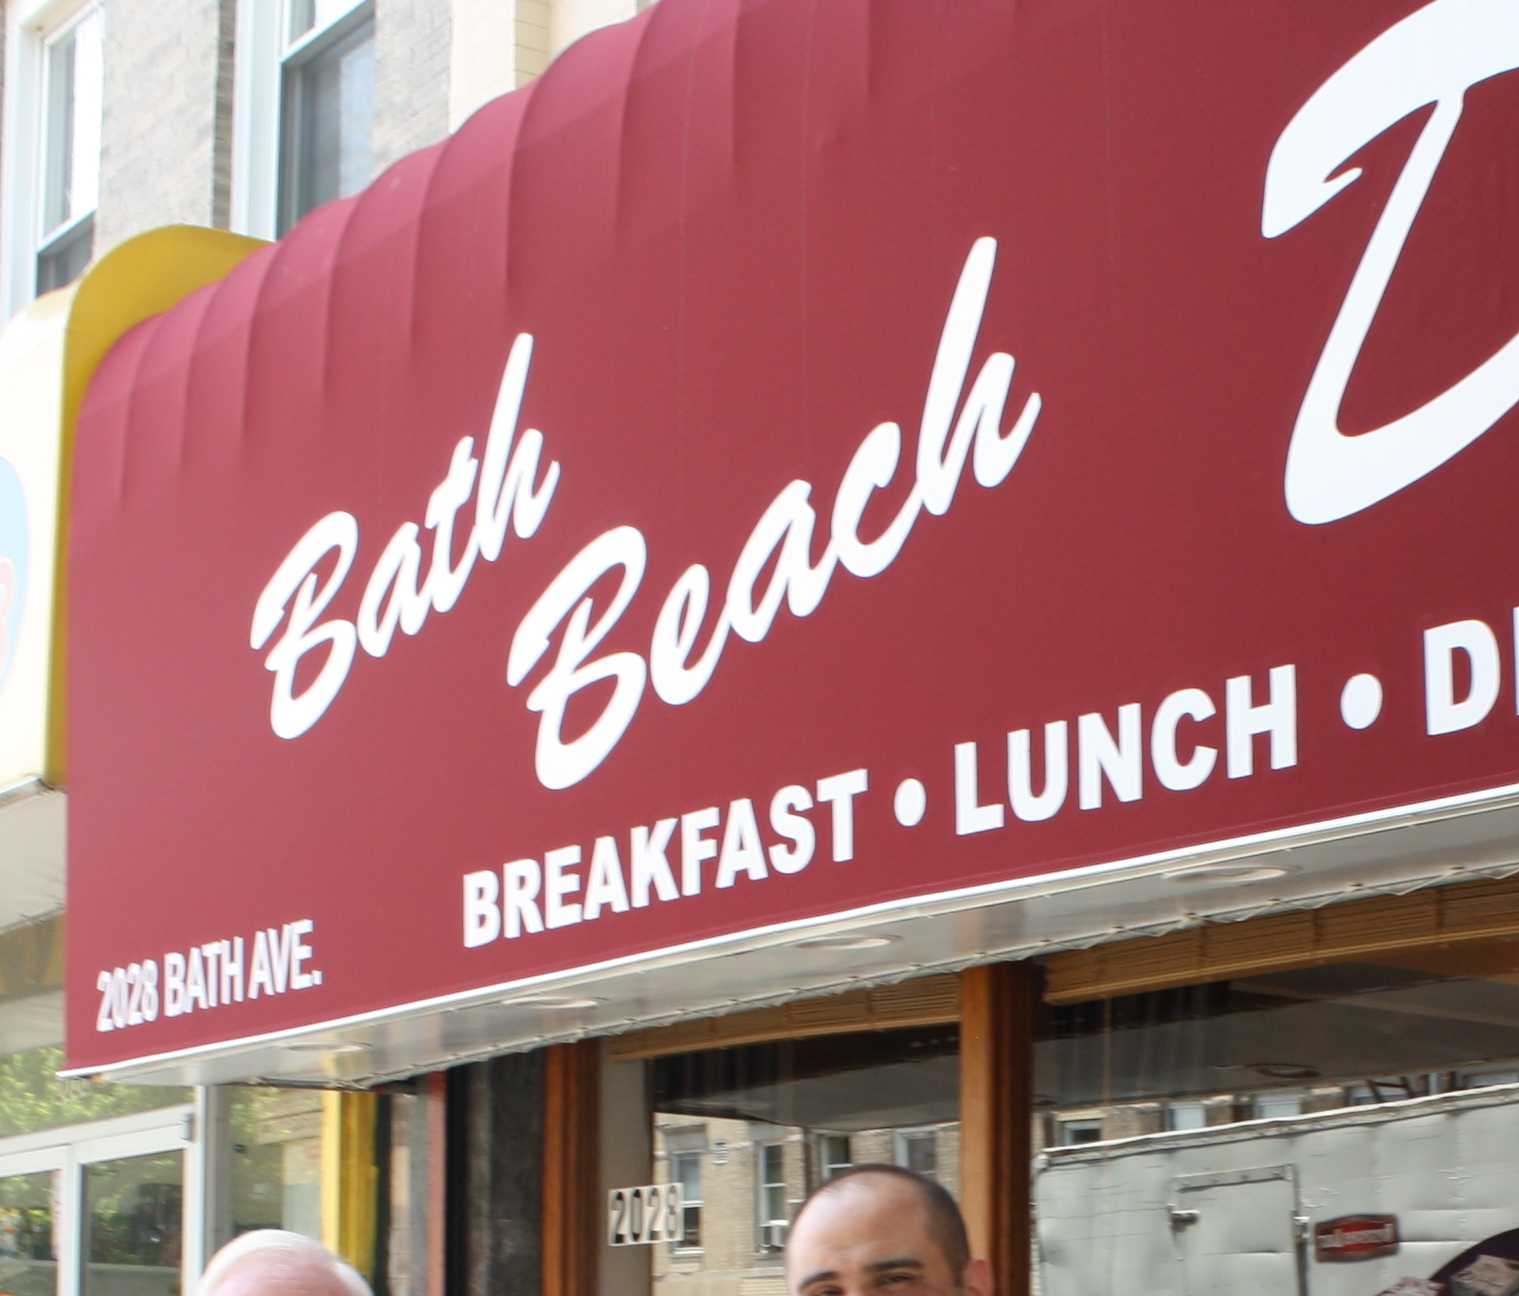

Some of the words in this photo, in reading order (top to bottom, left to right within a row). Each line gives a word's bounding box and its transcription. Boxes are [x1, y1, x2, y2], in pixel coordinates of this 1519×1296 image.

[249, 333, 561, 741] Bath
[506, 236, 1042, 791] Beach
[462, 768, 869, 949] BREAKFAST
[954, 664, 1298, 836] LUNCH
[95, 958, 160, 1033] 2028
[163, 935, 245, 1018] BATH
[247, 918, 323, 1000] AVE.
[609, 1184, 683, 1246] 2028
